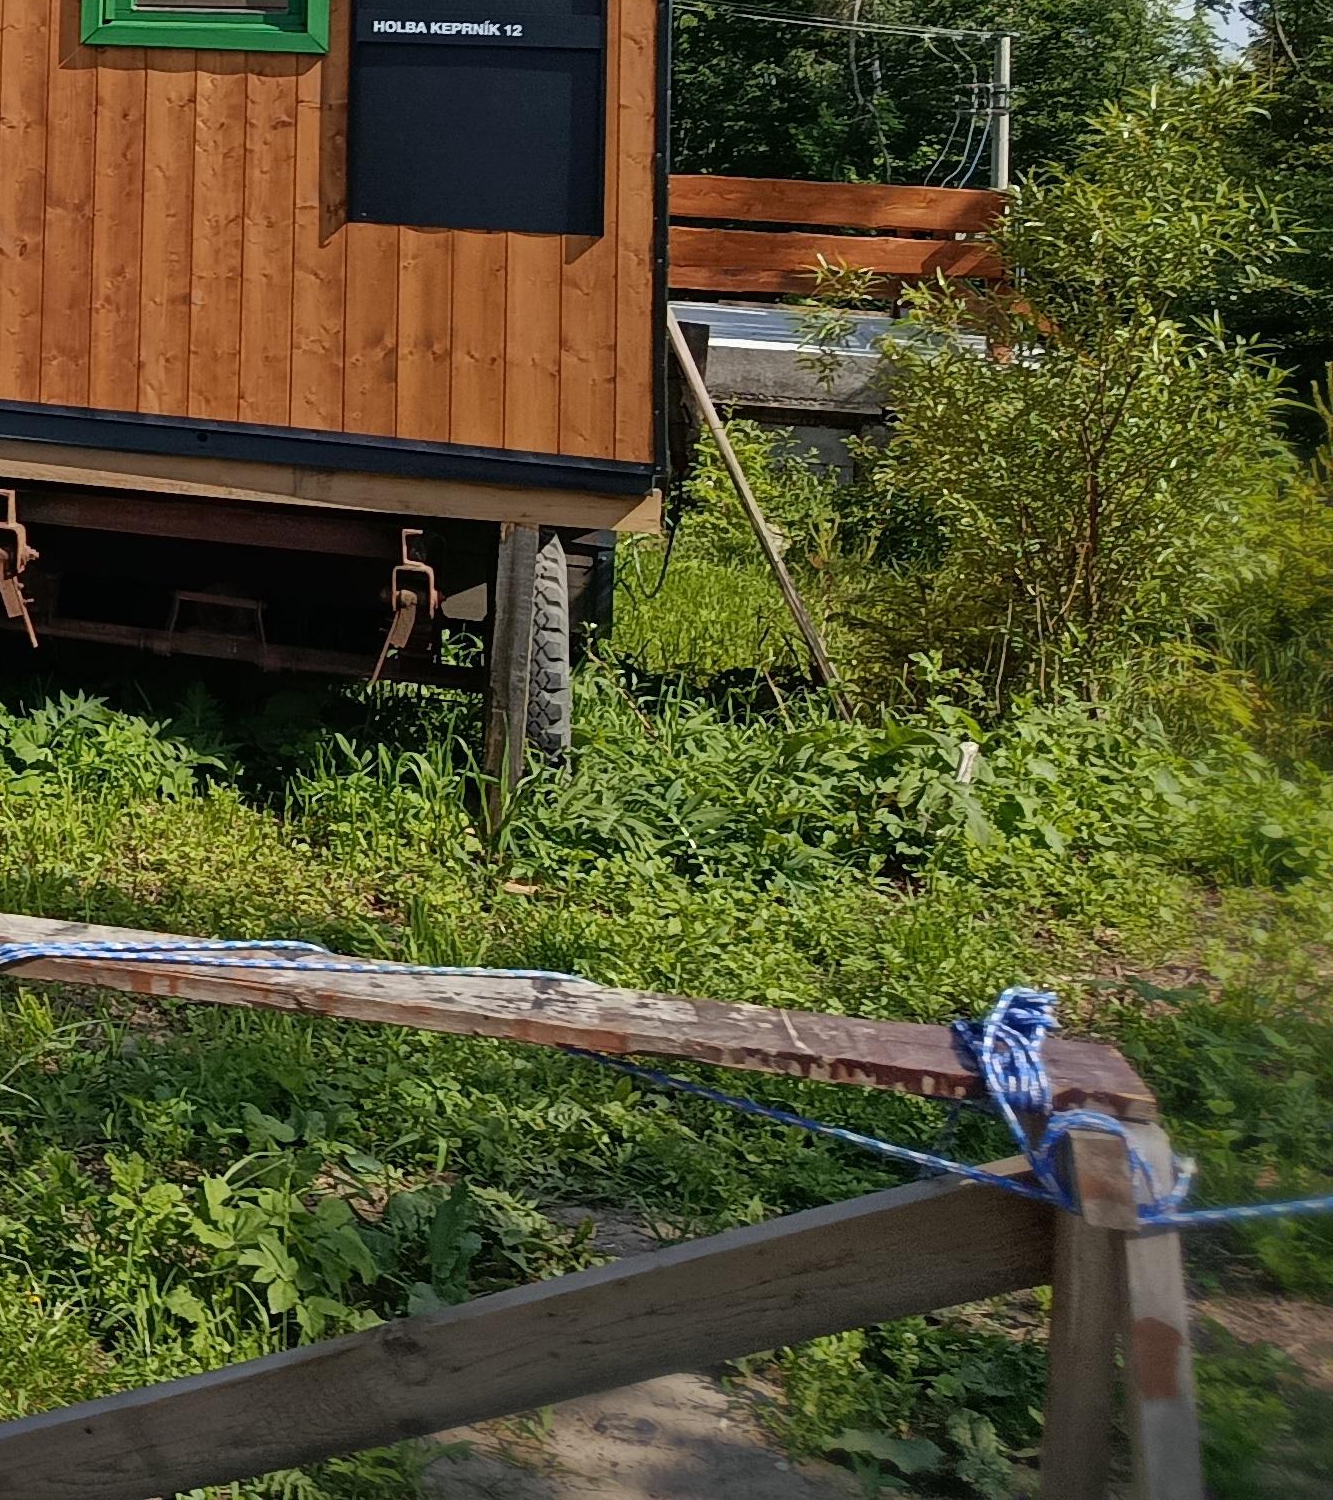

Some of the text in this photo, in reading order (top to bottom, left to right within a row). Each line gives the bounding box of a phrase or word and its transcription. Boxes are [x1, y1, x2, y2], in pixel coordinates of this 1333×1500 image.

[373, 20, 523, 36] HOLBA KEPRNÍK 12
